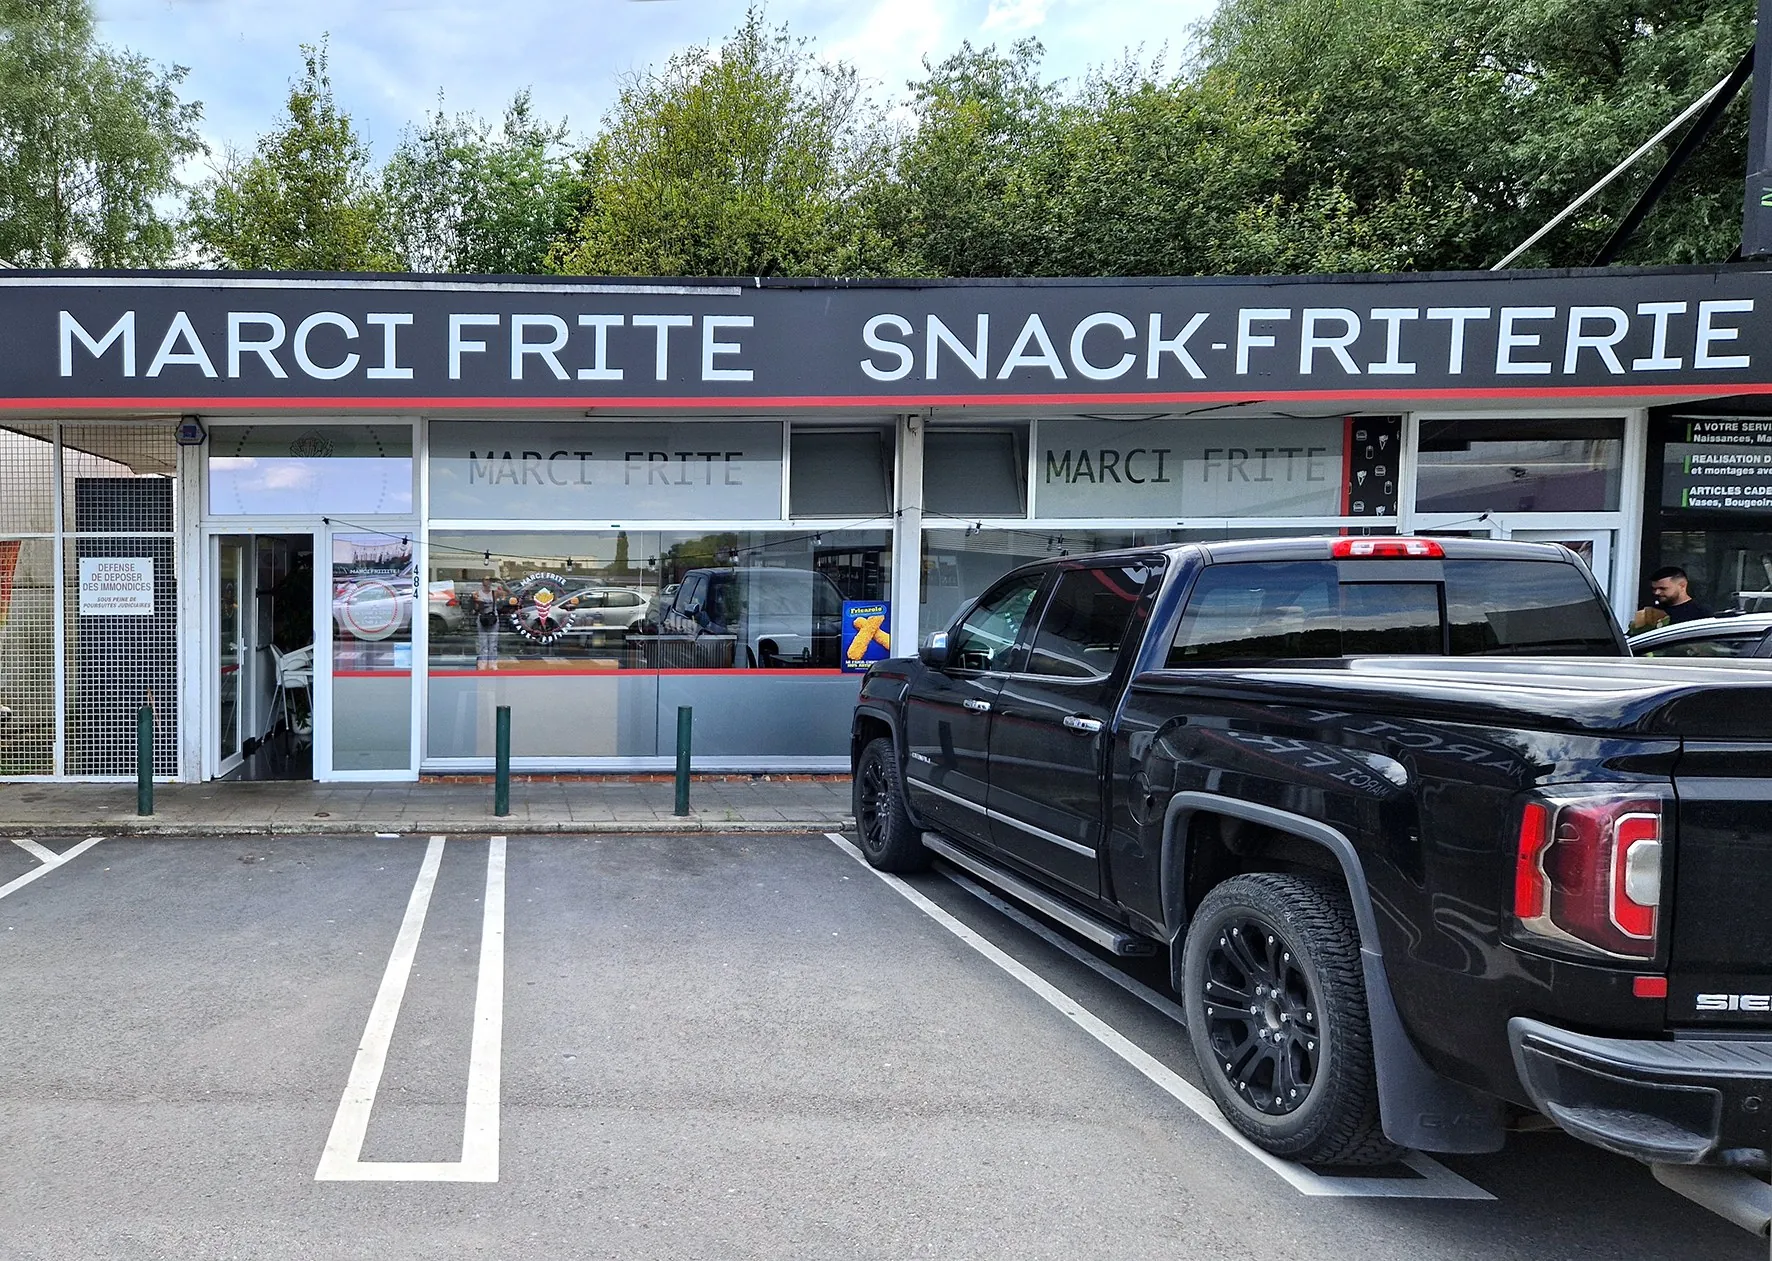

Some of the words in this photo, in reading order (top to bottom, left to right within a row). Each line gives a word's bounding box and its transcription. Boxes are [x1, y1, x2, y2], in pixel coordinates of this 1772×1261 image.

[860, 299, 1755, 381] SNACK-FRITERIE
[60, 310, 414, 380] MARCI
[448, 313, 754, 382] FRITE
[1694, 423, 1701, 431] A
[1704, 422, 1738, 431] VOTRE
[1693, 434, 1754, 444] Naissances,
[1692, 454, 1761, 464] REALISATION
[469, 450, 593, 485] MARCI
[623, 451, 744, 486] FRITE
[1046, 448, 1171, 484] MARCI
[1203, 447, 1327, 483] FRITE
[1691, 466, 1702, 475] et
[1704, 466, 1755, 477] montages
[1689, 486, 1741, 495] ARTICLES
[1689, 497, 1722, 508] Vases,
[98, 563, 135, 572] DEFENSE
[91, 573, 103, 582] DE
[104, 573, 143, 582] DEPOSER
[520, 572, 544, 586] MARCI
[546, 572, 567, 586] FRITE
[82, 583, 99, 591] DES
[100, 583, 152, 591] IMMONDICES
